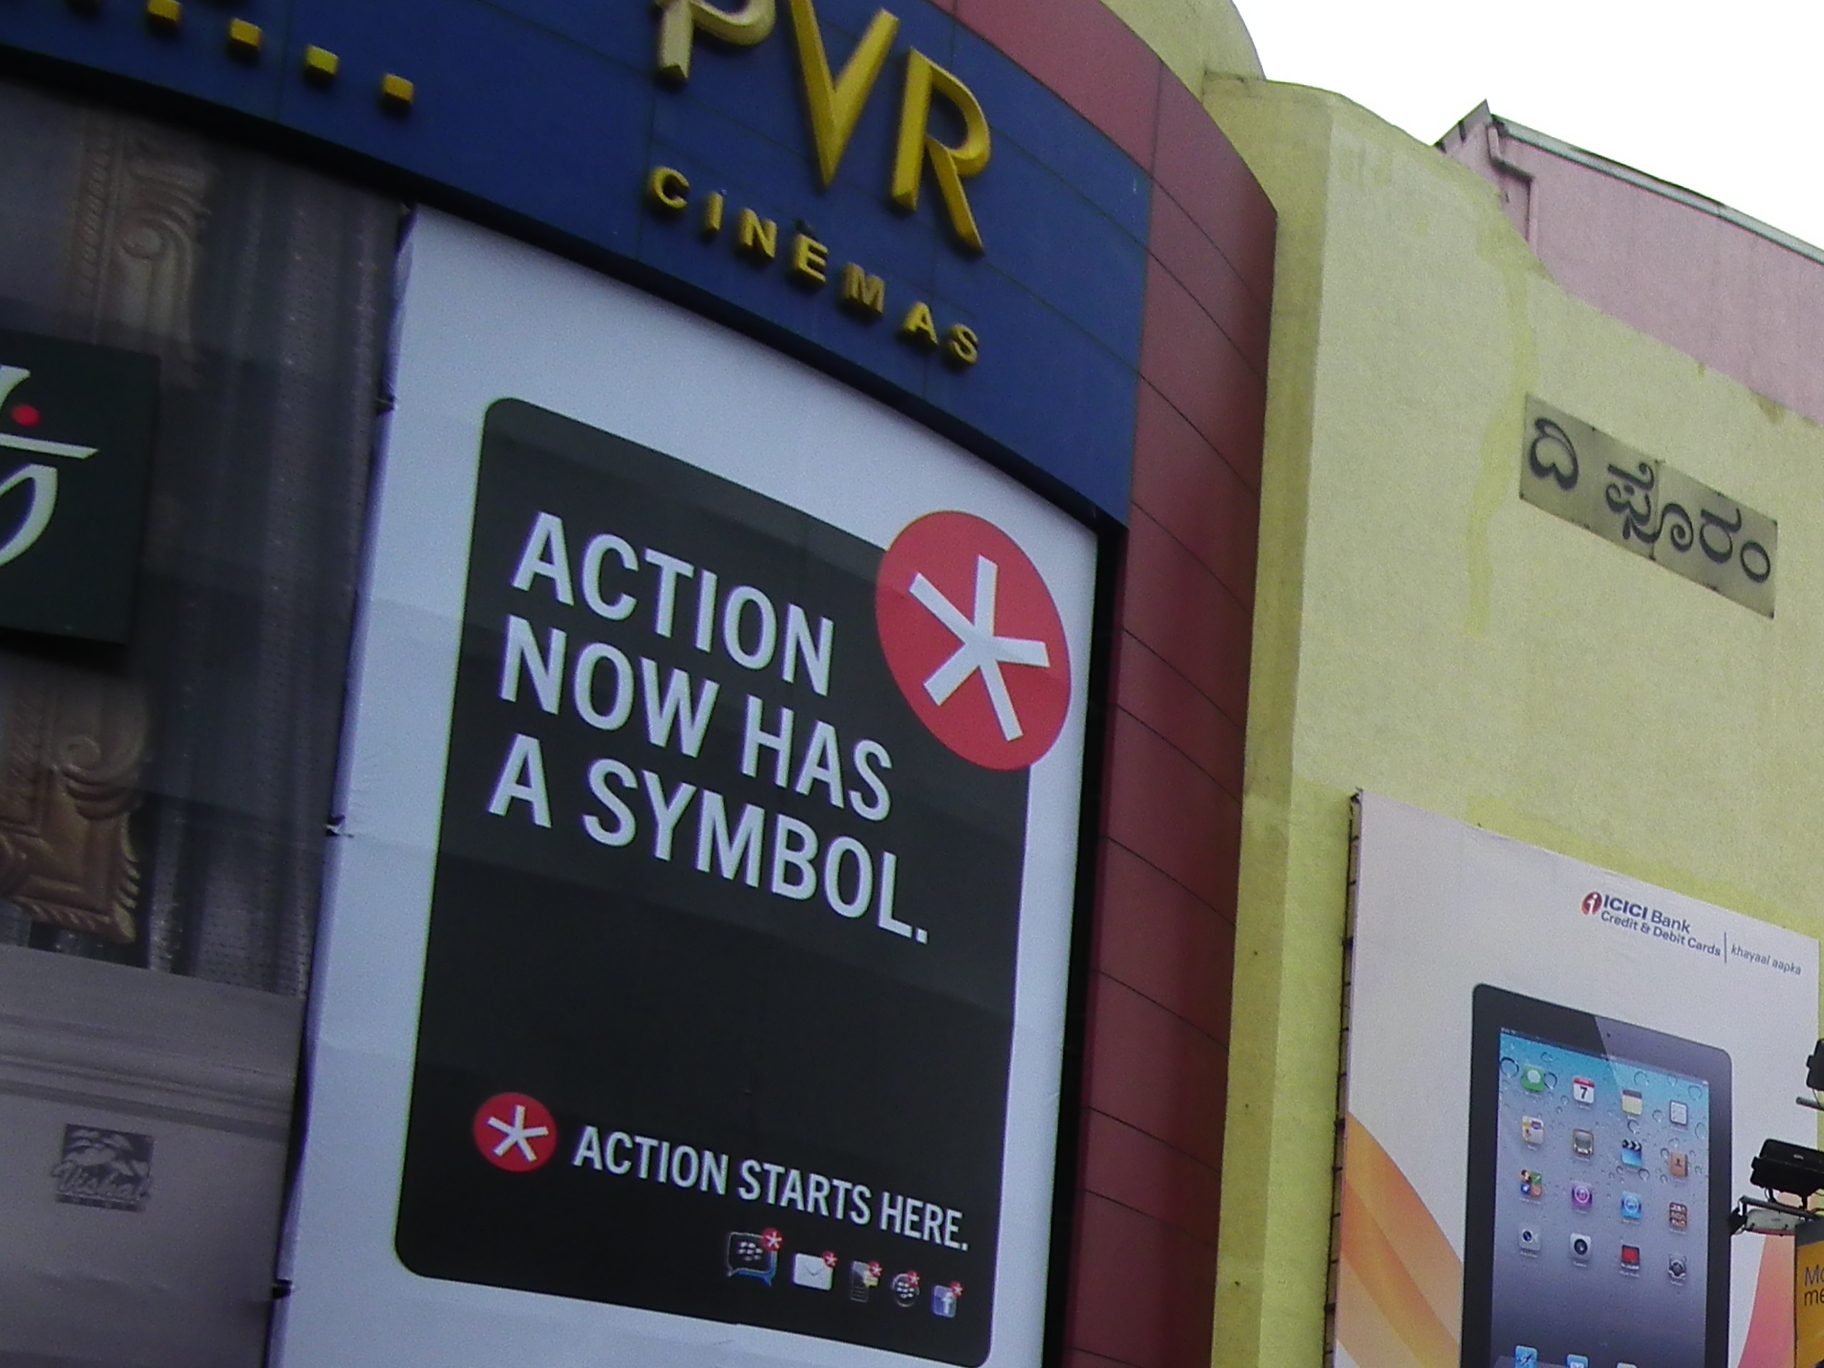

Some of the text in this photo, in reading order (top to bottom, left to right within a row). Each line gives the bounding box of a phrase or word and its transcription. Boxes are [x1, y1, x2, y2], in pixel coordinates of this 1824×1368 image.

[650, 166, 979, 366] CINEMAS
[1528, 417, 1579, 491] ದಿ
[512, 510, 835, 697] ACTION
[499, 613, 894, 823] NOW HAS
[488, 733, 929, 945] A SYMBOL.
[1603, 894, 1691, 934] ICICI Bank
[1600, 911, 1722, 957] Credit & Debit Cards
[572, 1124, 969, 1252] ACTION STARTS HERE.
